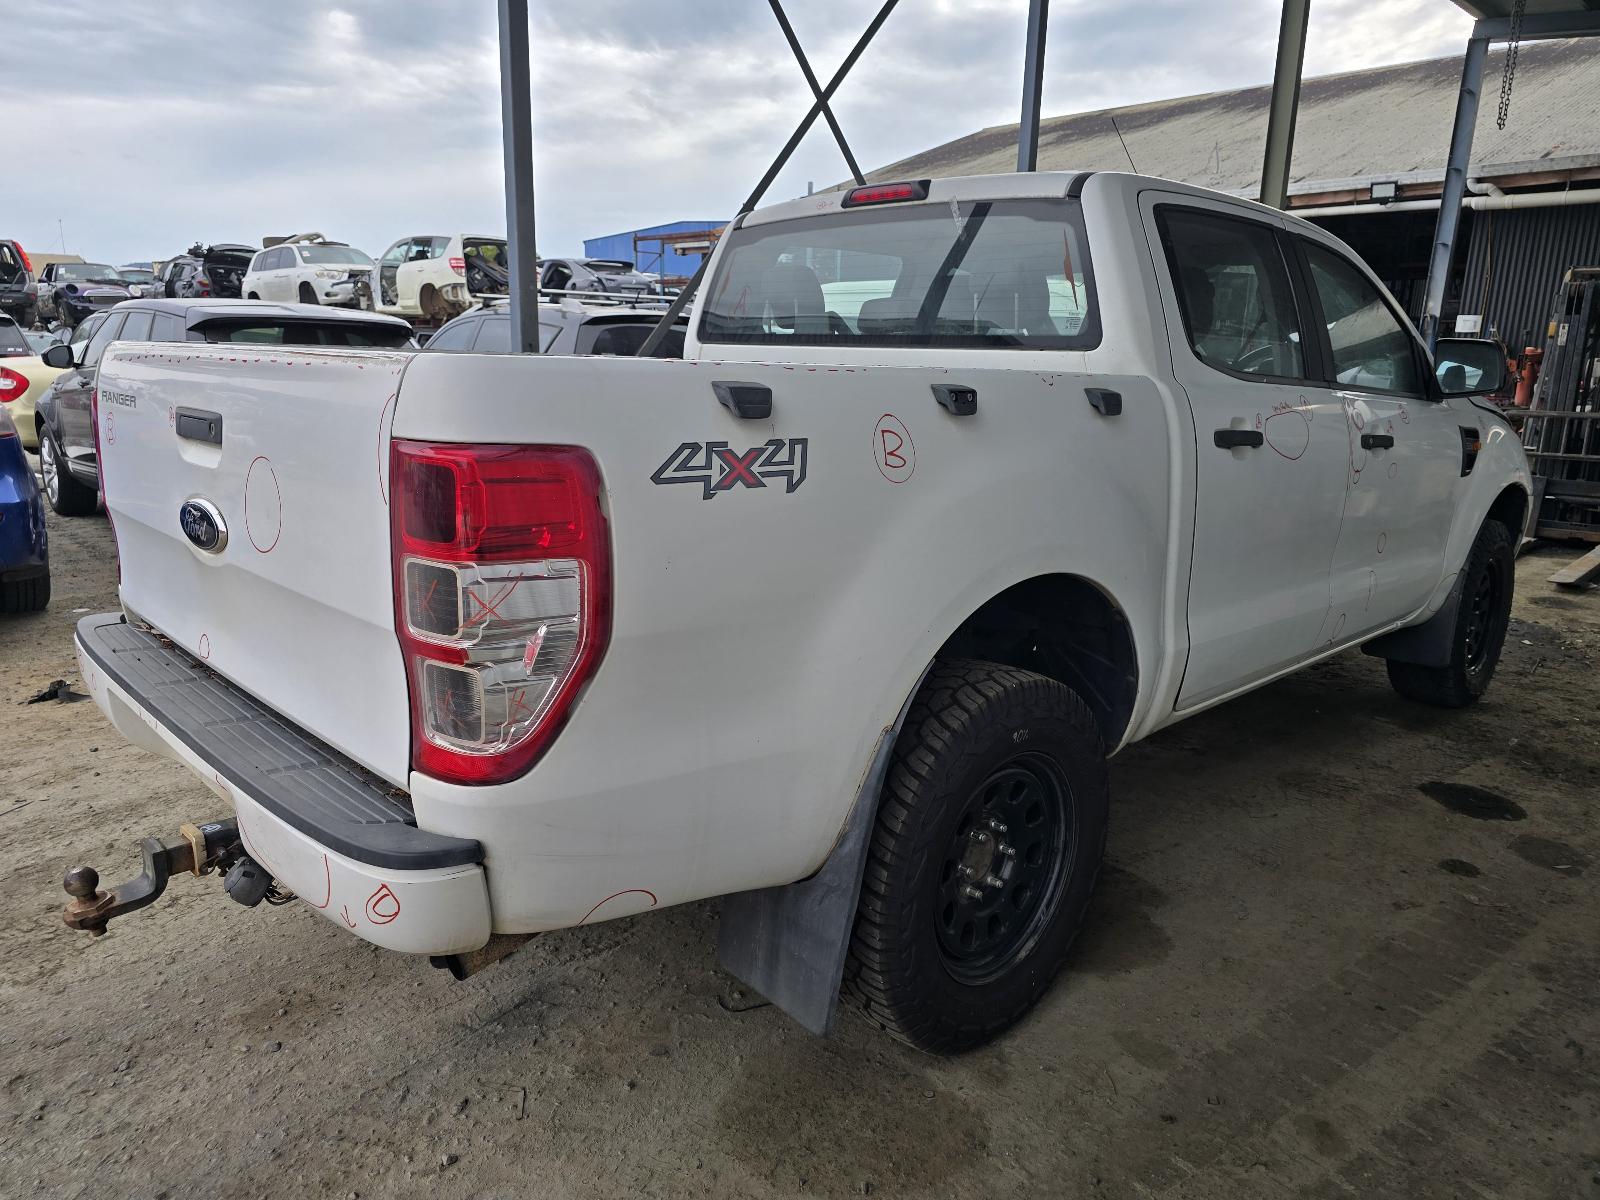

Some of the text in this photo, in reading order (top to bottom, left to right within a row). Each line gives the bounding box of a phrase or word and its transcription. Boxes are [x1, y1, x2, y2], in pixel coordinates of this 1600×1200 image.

[101, 390, 137, 409] RANGER
[881, 429, 907, 469] B
[183, 506, 207, 542] Ford
